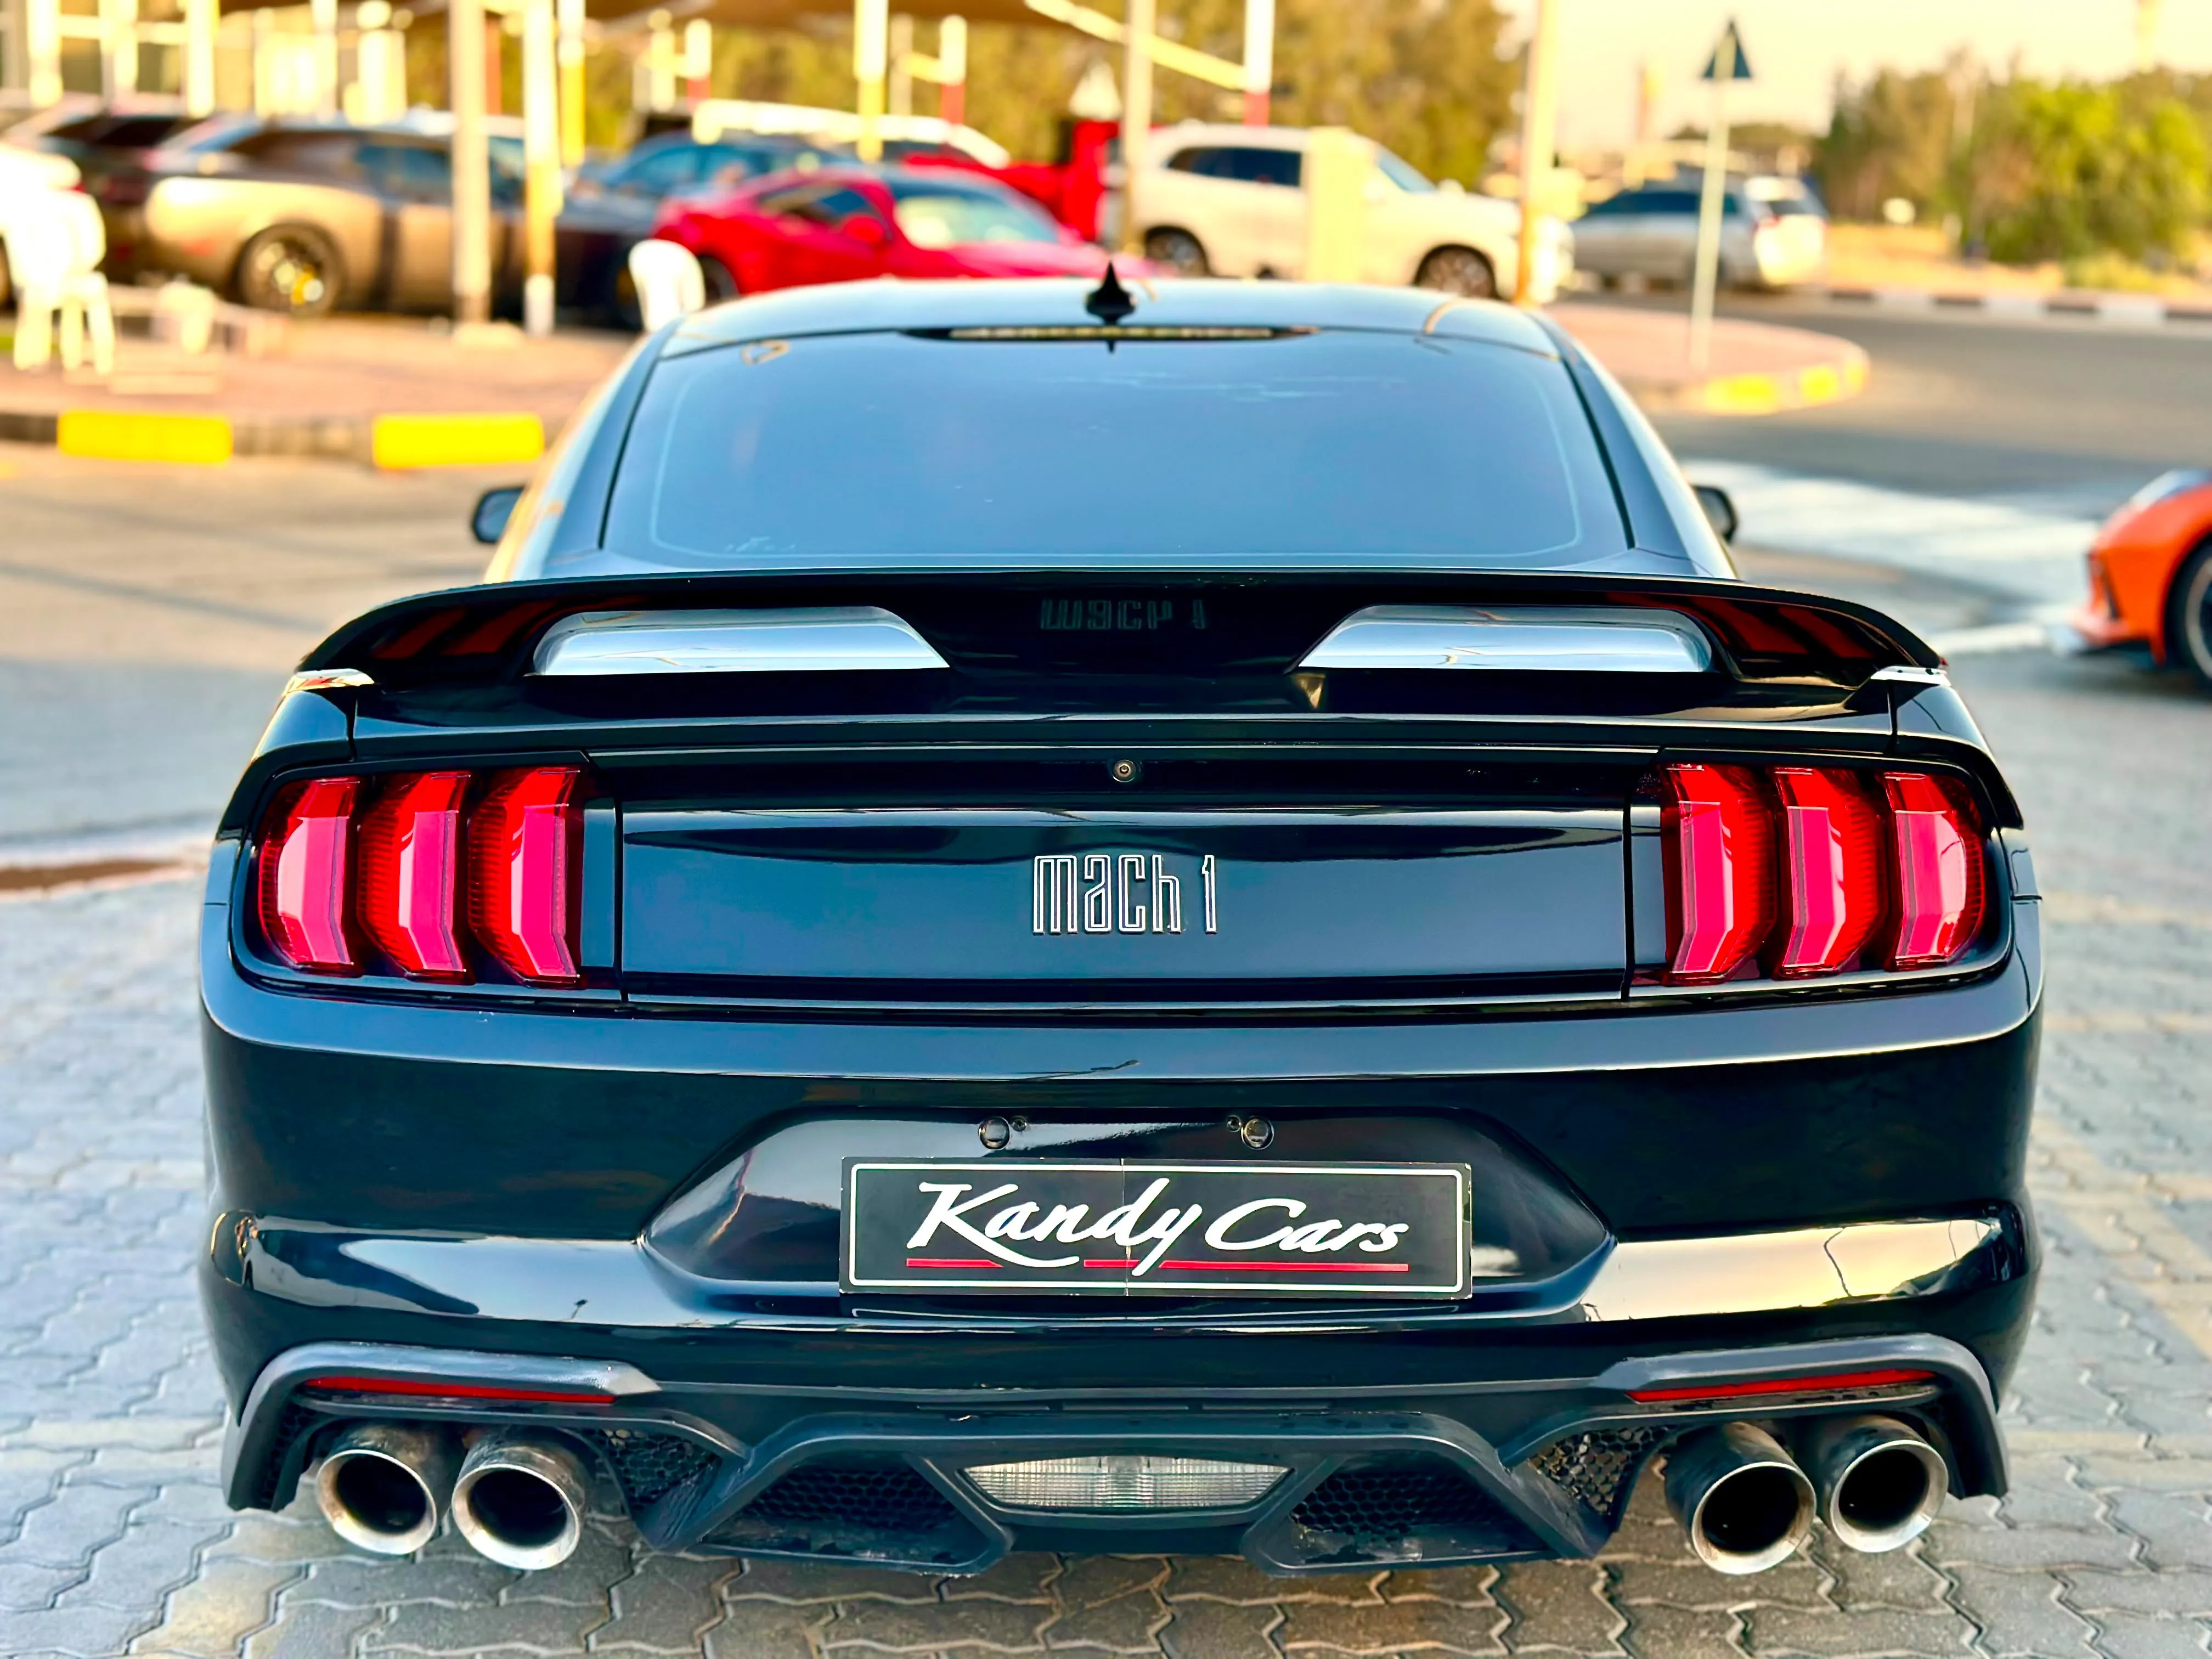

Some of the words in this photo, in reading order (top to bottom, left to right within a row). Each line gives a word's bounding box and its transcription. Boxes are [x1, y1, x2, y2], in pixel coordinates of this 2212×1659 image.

[1201, 854, 1217, 934] 1
[906, 1177, 1203, 1277] Kandy
[1204, 1198, 1409, 1252] Cars
